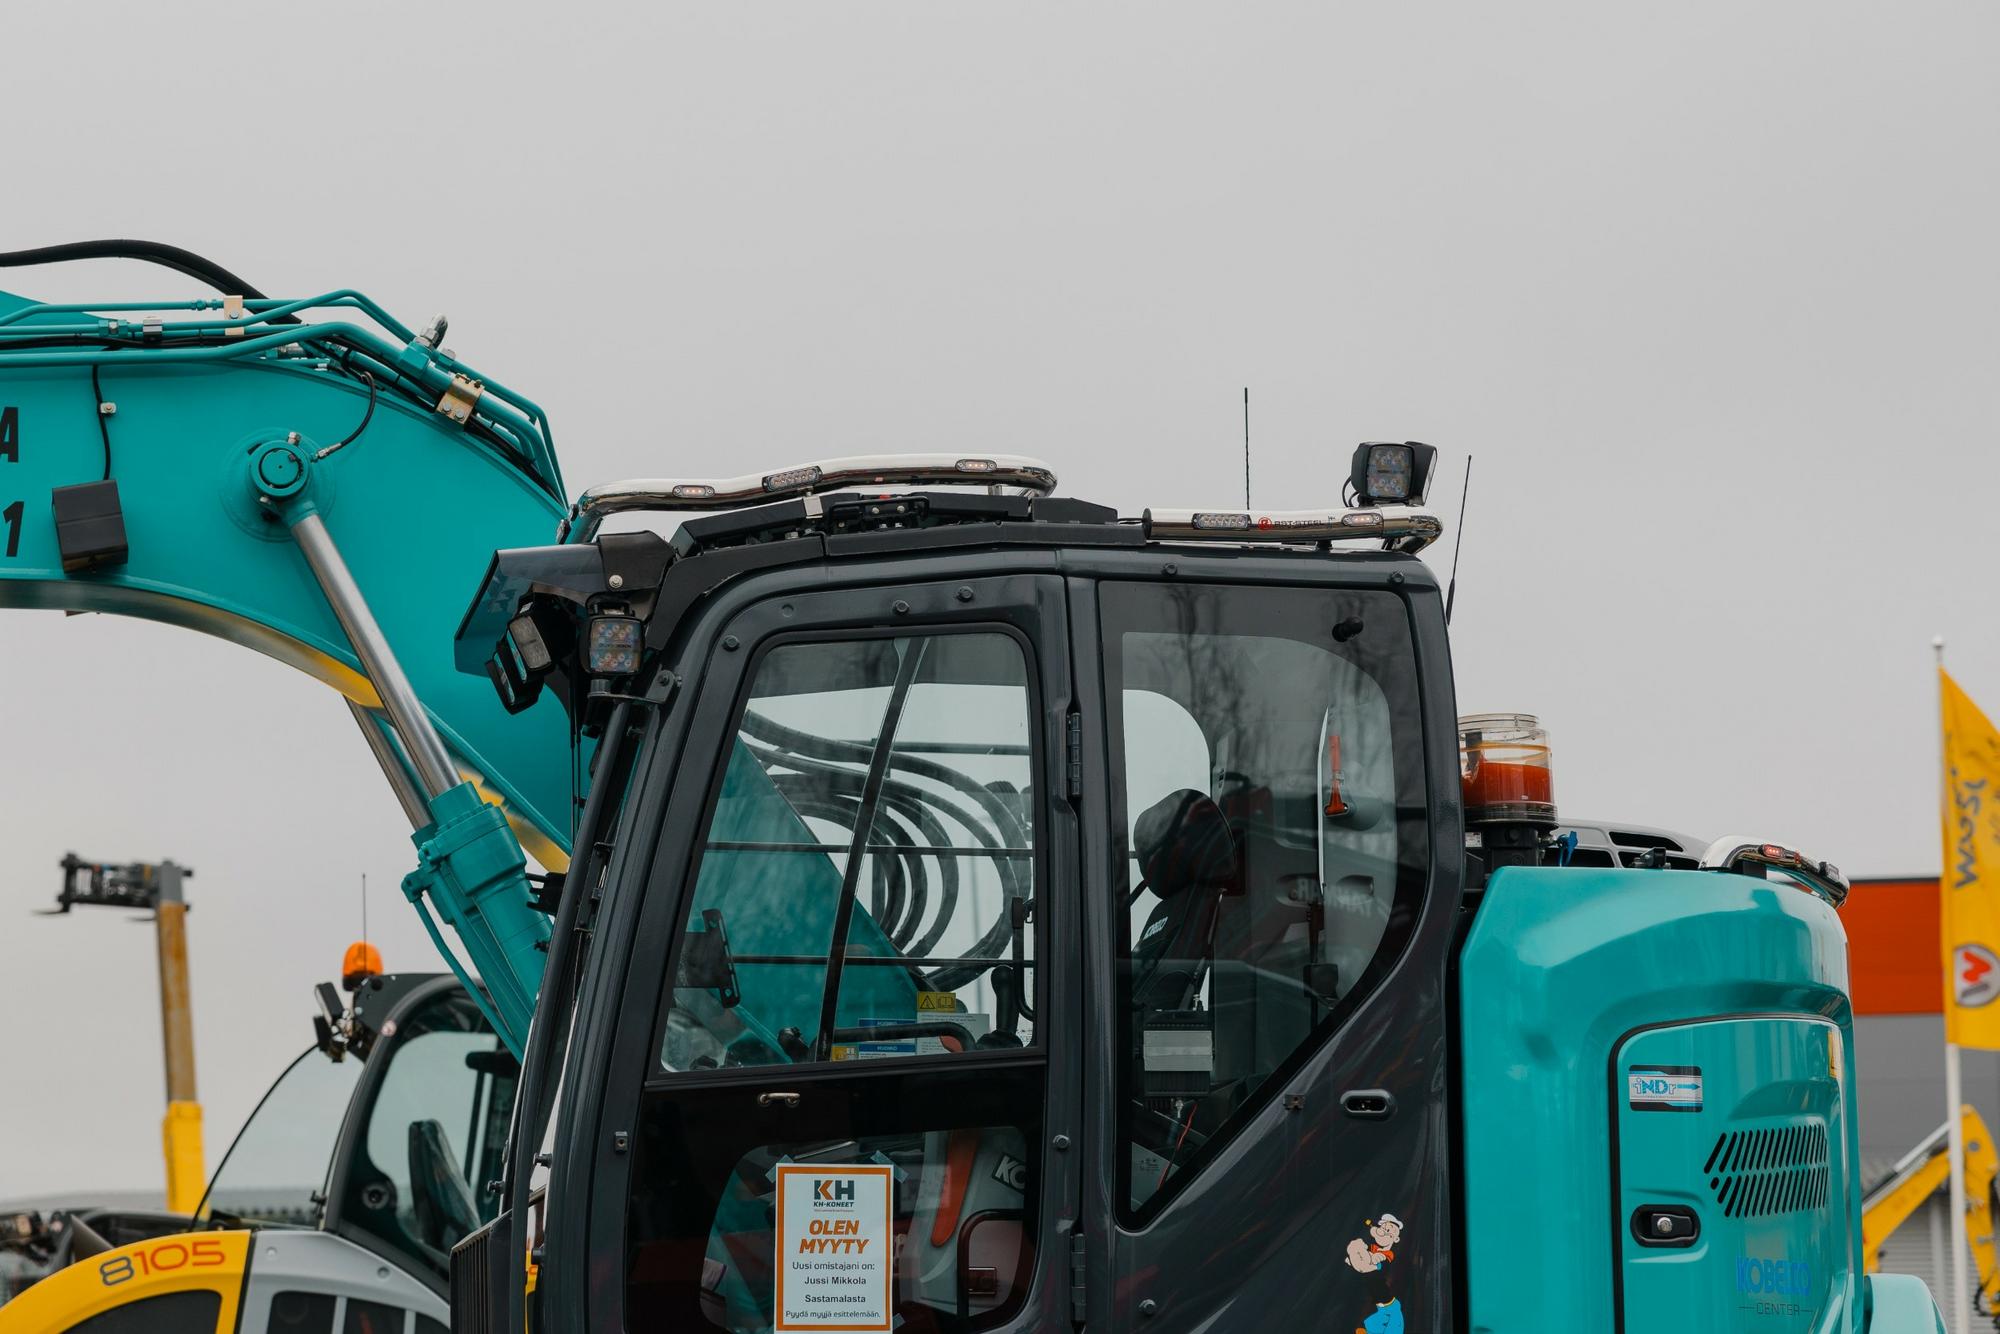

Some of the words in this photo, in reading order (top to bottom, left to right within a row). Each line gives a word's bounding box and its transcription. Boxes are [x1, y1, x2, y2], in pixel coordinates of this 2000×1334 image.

[814, 1180, 855, 1200] KH
[809, 1219, 859, 1235] OLEN
[799, 1239, 869, 1254] MYYTY
[99, 1241, 225, 1286] 8105
[792, 1262, 812, 1270] Uusi
[814, 1262, 859, 1272] omistajani
[804, 1276, 829, 1285] Jussi
[832, 1276, 867, 1285] Mikkola
[805, 1294, 866, 1303] Sastamalasta
[1756, 1302, 1800, 1316] CENTER
